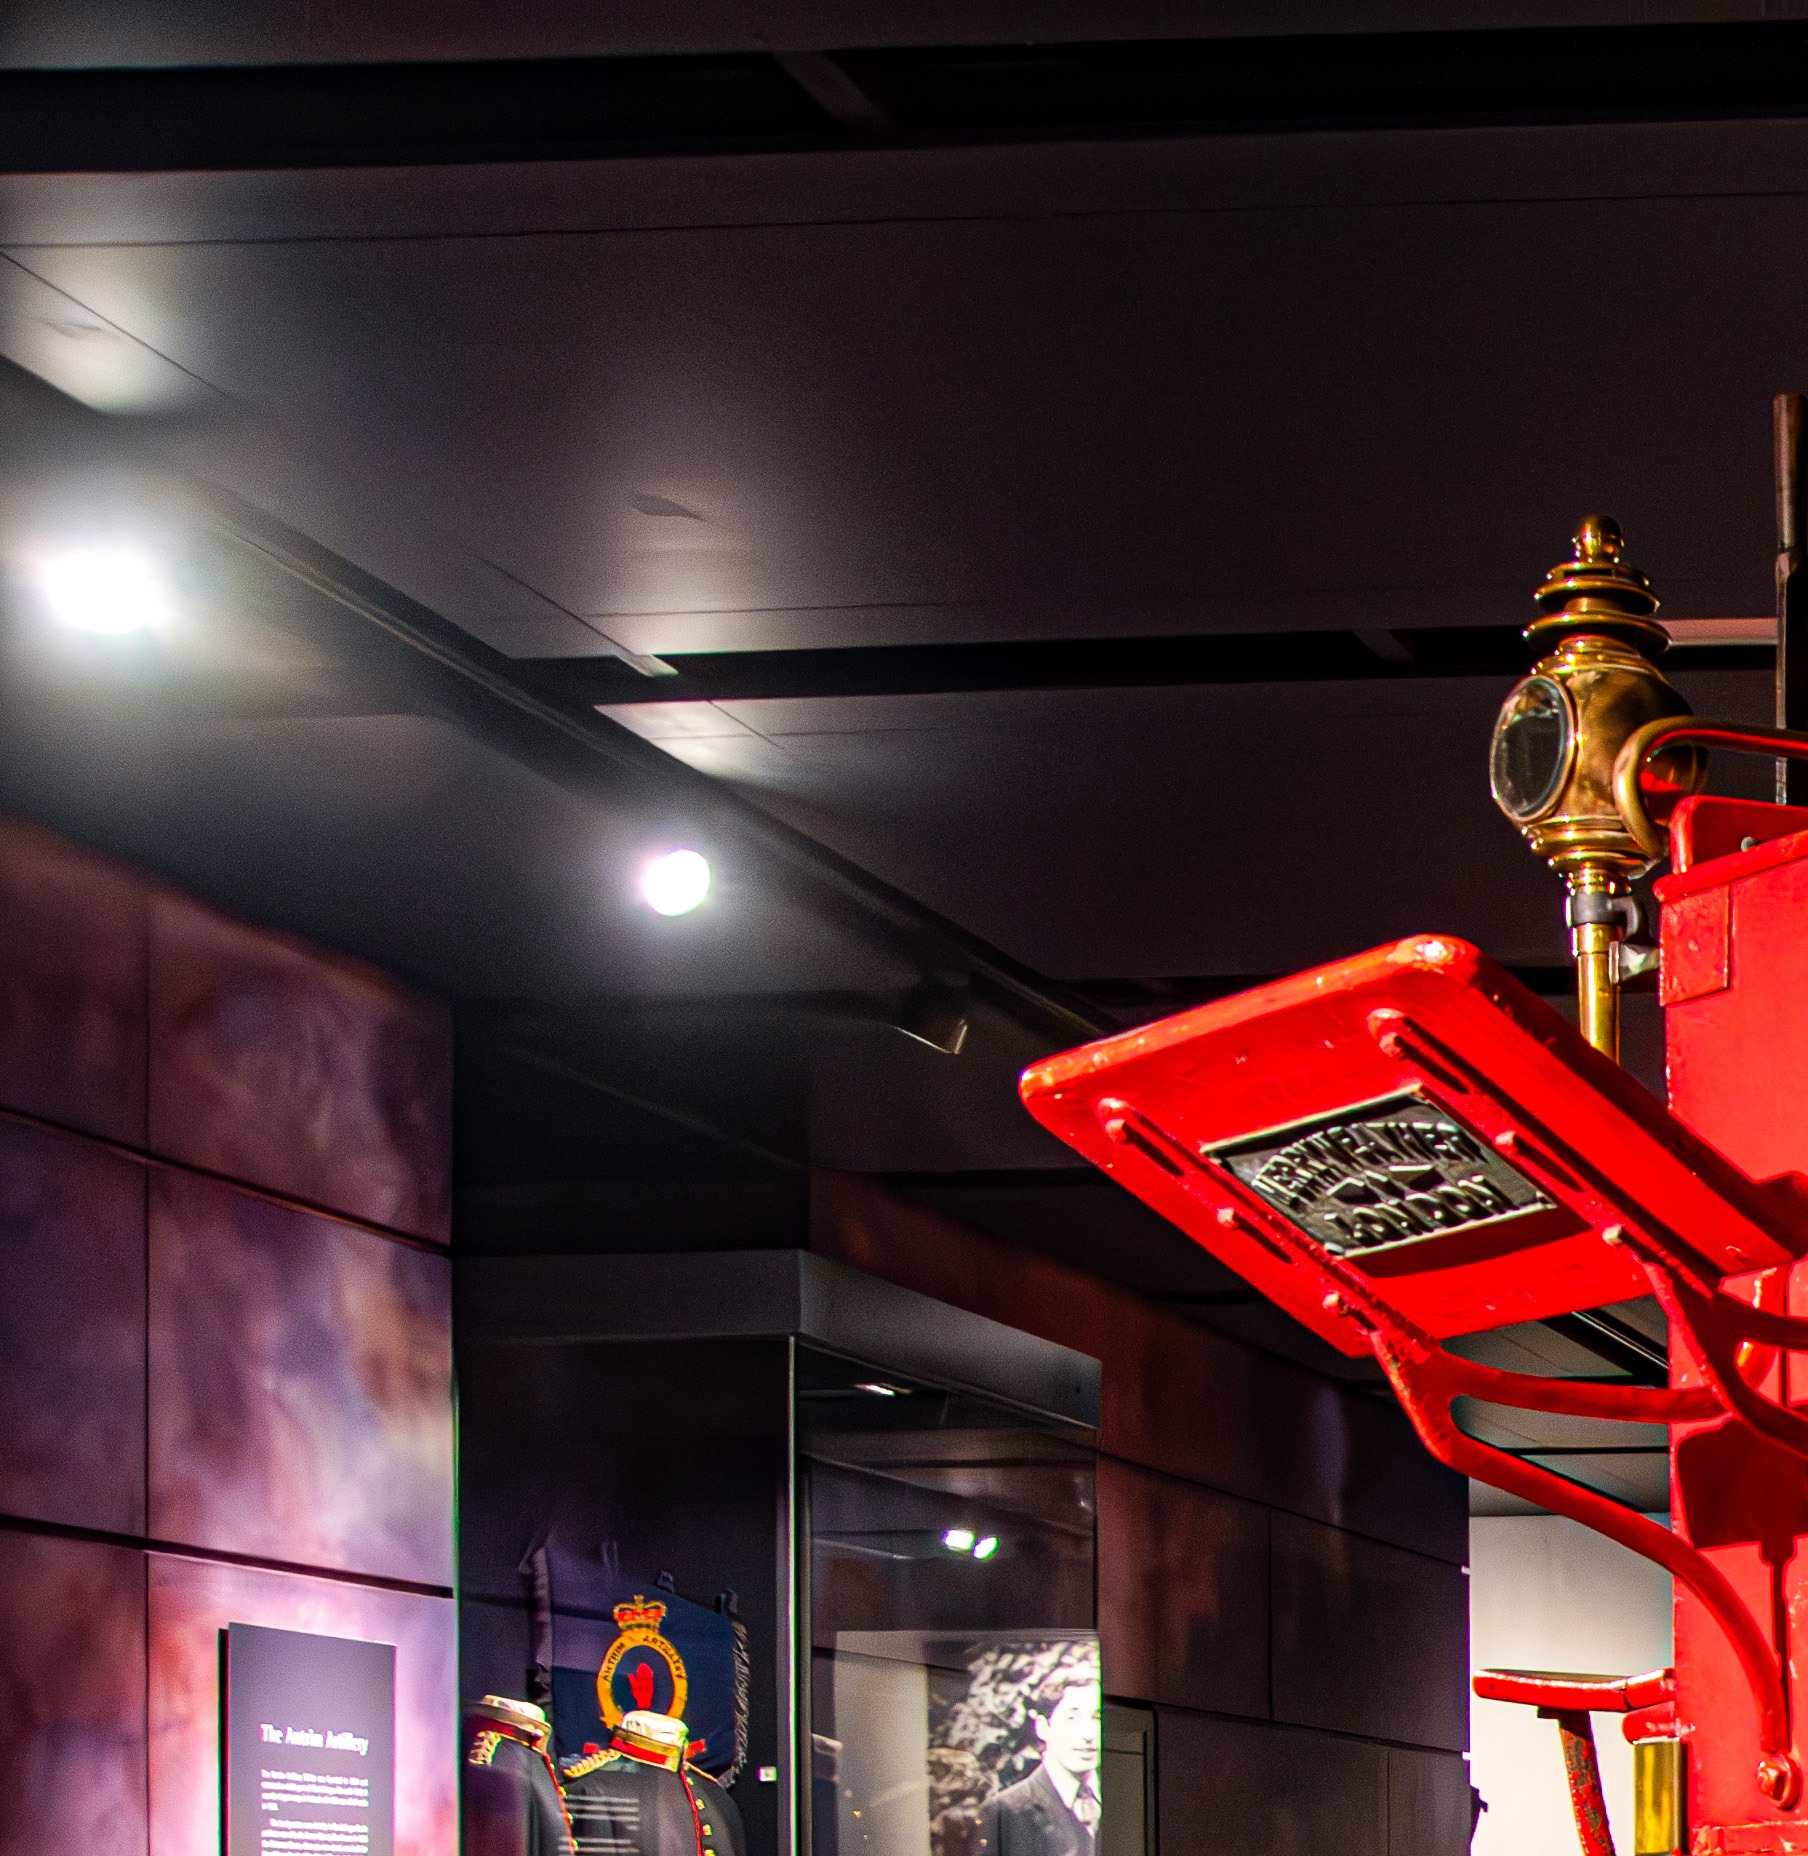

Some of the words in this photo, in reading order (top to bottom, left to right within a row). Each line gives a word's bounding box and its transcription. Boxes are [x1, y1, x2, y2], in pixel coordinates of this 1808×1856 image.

[1323, 1174, 1518, 1246] LONDON
[260, 1723, 284, 1744] The
[284, 1726, 324, 1748] Antrim
[325, 1730, 369, 1756] Artillery
